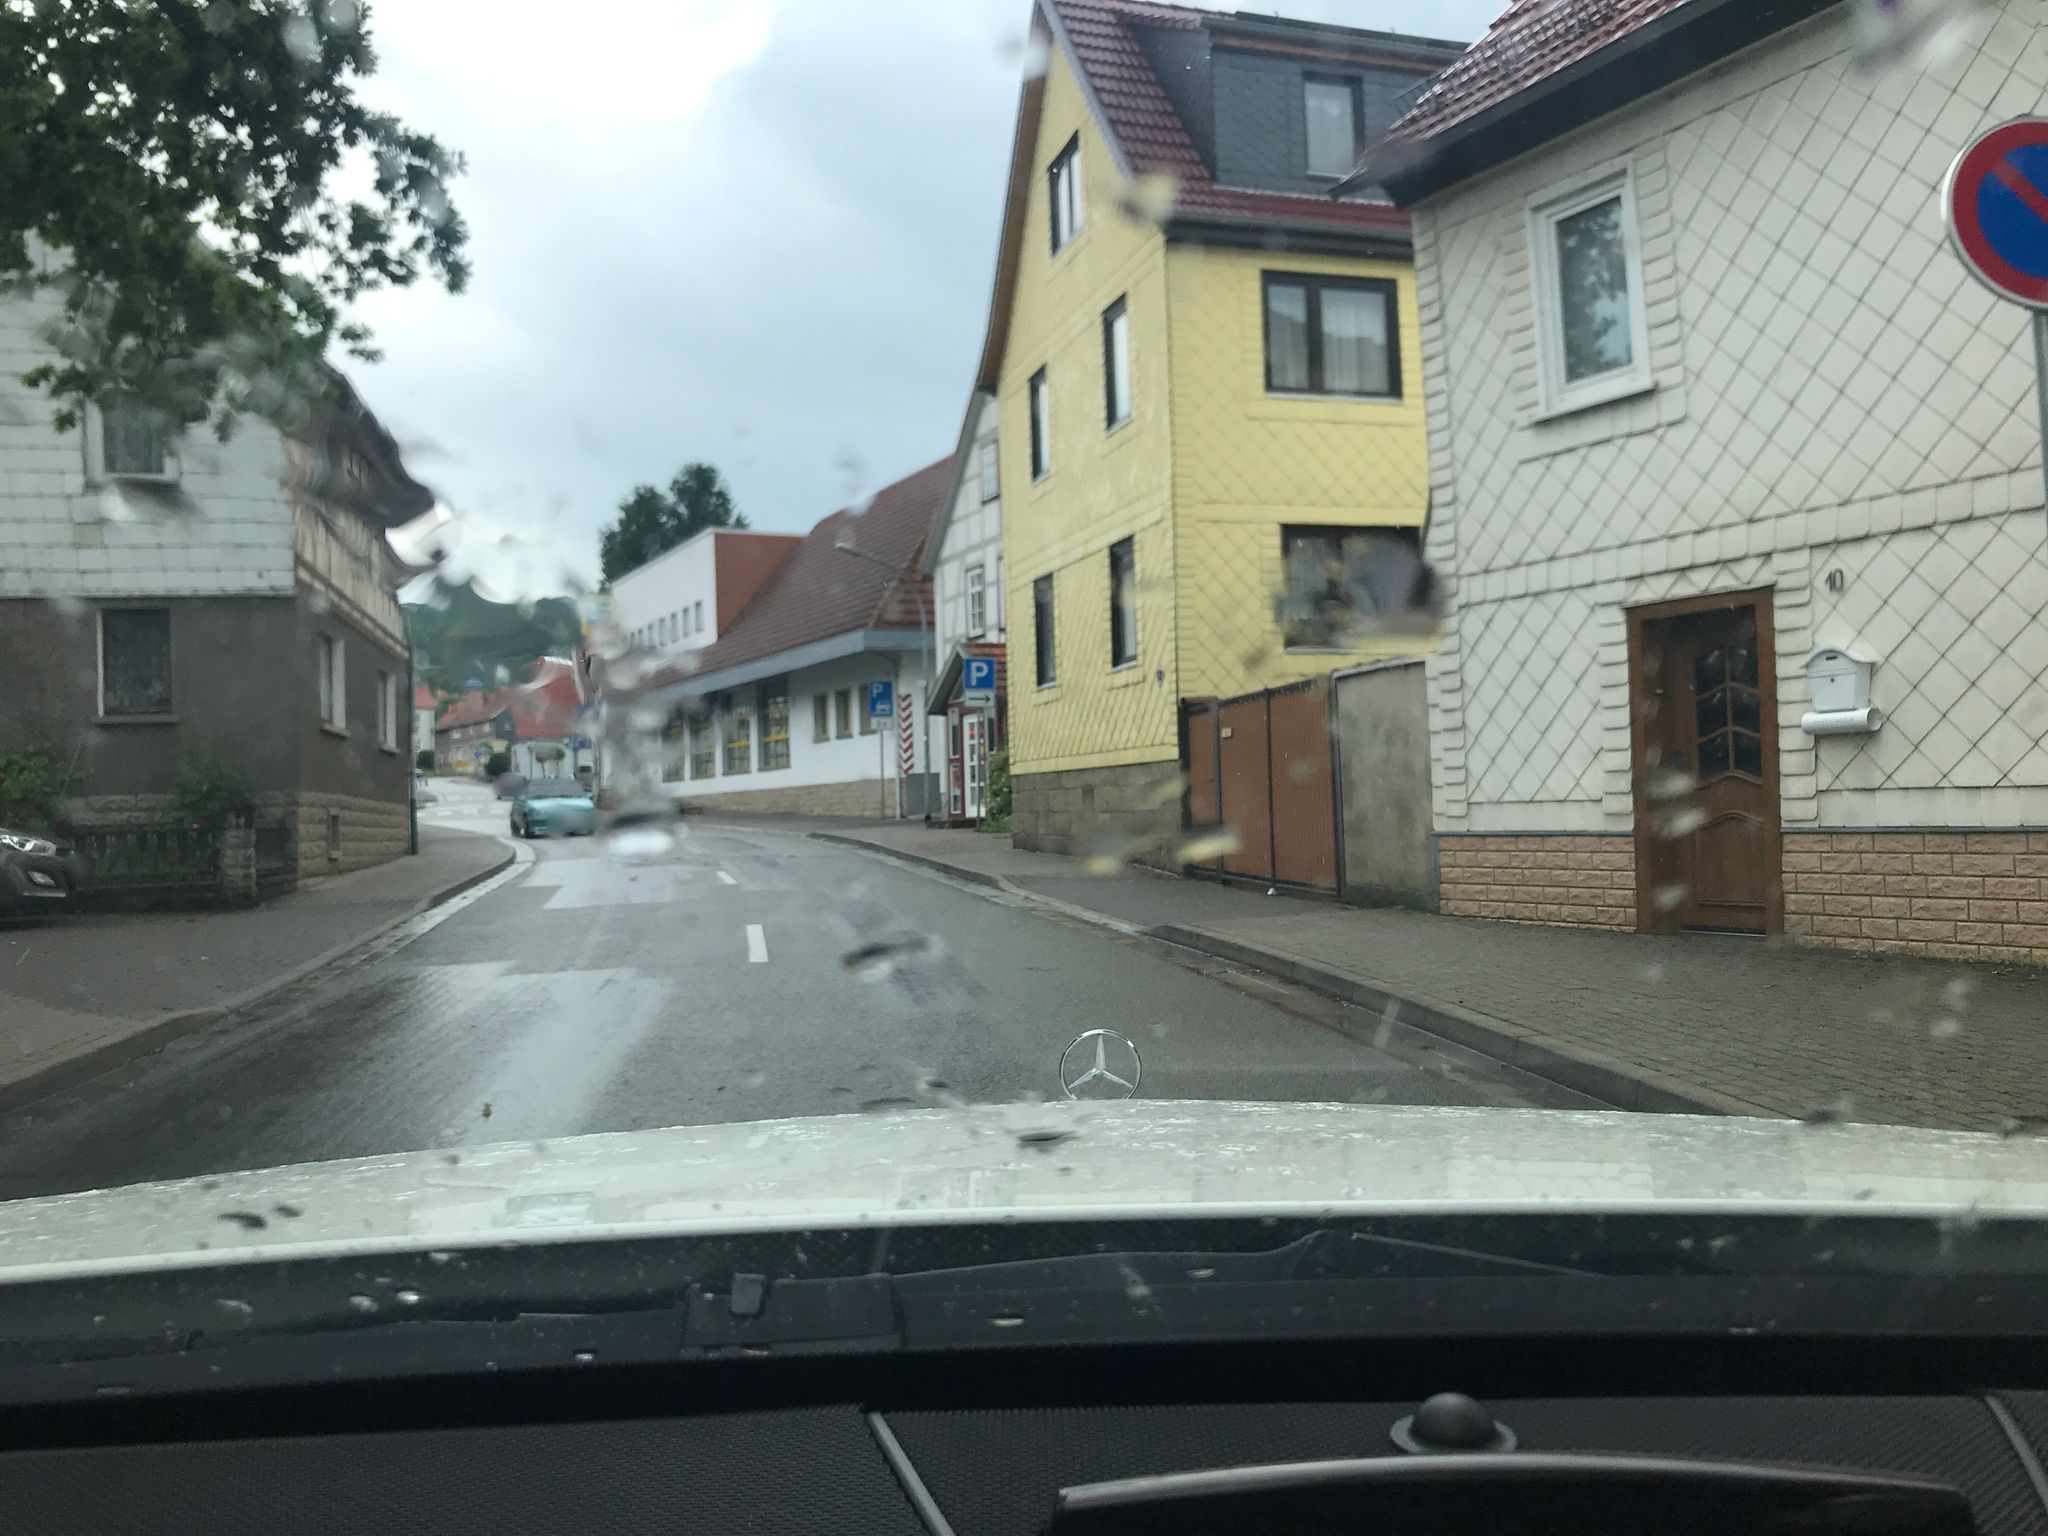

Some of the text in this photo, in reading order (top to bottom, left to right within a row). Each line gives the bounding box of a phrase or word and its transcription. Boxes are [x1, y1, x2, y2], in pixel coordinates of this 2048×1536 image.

[1825, 568, 1843, 592] 10
[971, 662, 988, 686] P
[873, 684, 883, 697] P
